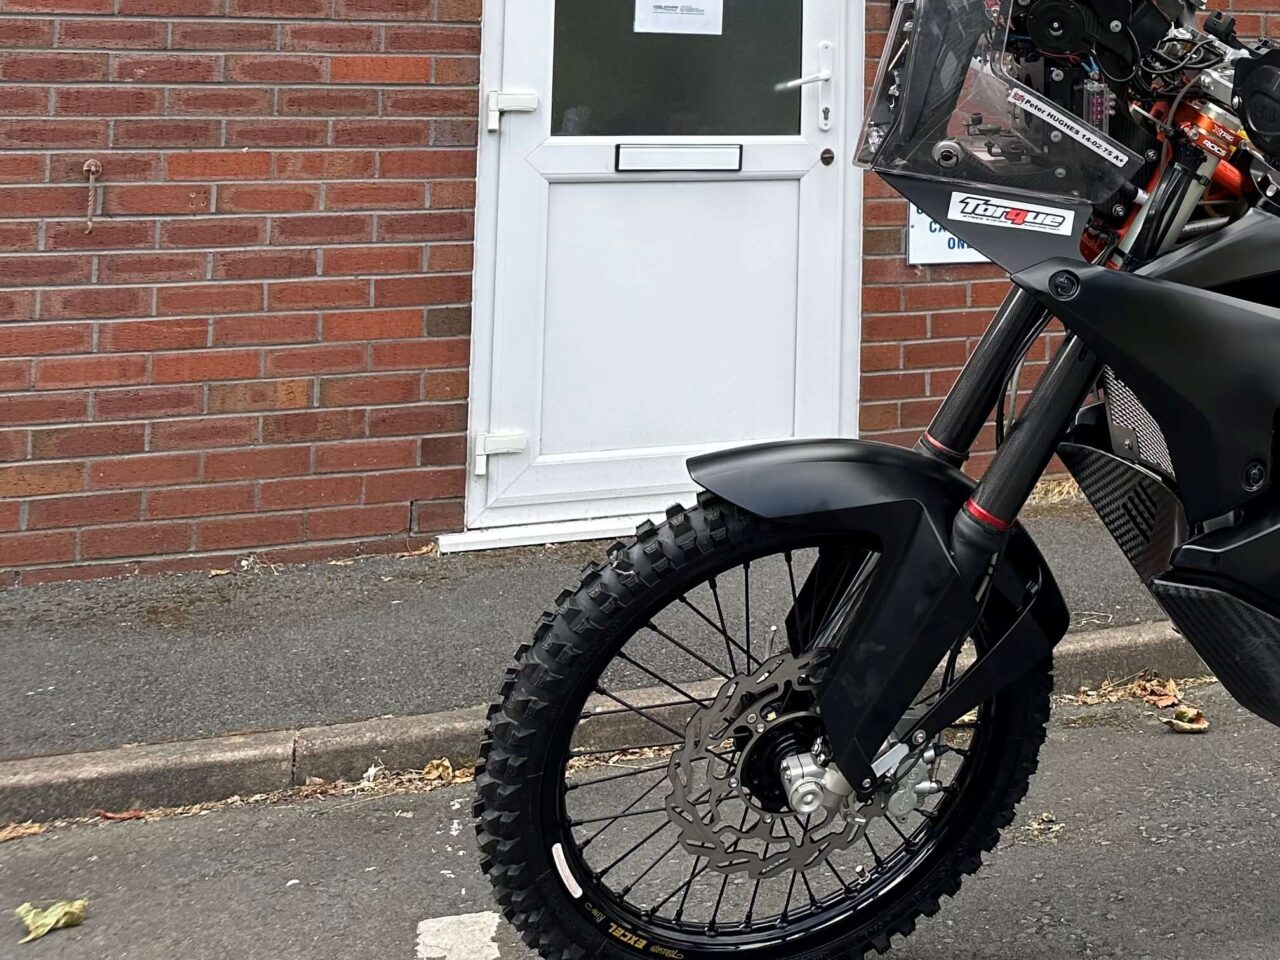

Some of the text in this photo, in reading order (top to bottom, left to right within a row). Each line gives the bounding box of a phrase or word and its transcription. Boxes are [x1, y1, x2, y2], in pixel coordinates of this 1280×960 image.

[1024, 99, 1046, 114] Peter
[1046, 112, 1079, 135] HUGHES
[1082, 134, 1113, 156] 14-02-75
[1203, 140, 1227, 156] ROCS
[959, 197, 1065, 227] Torque
[608, 922, 648, 949] EXCEL
